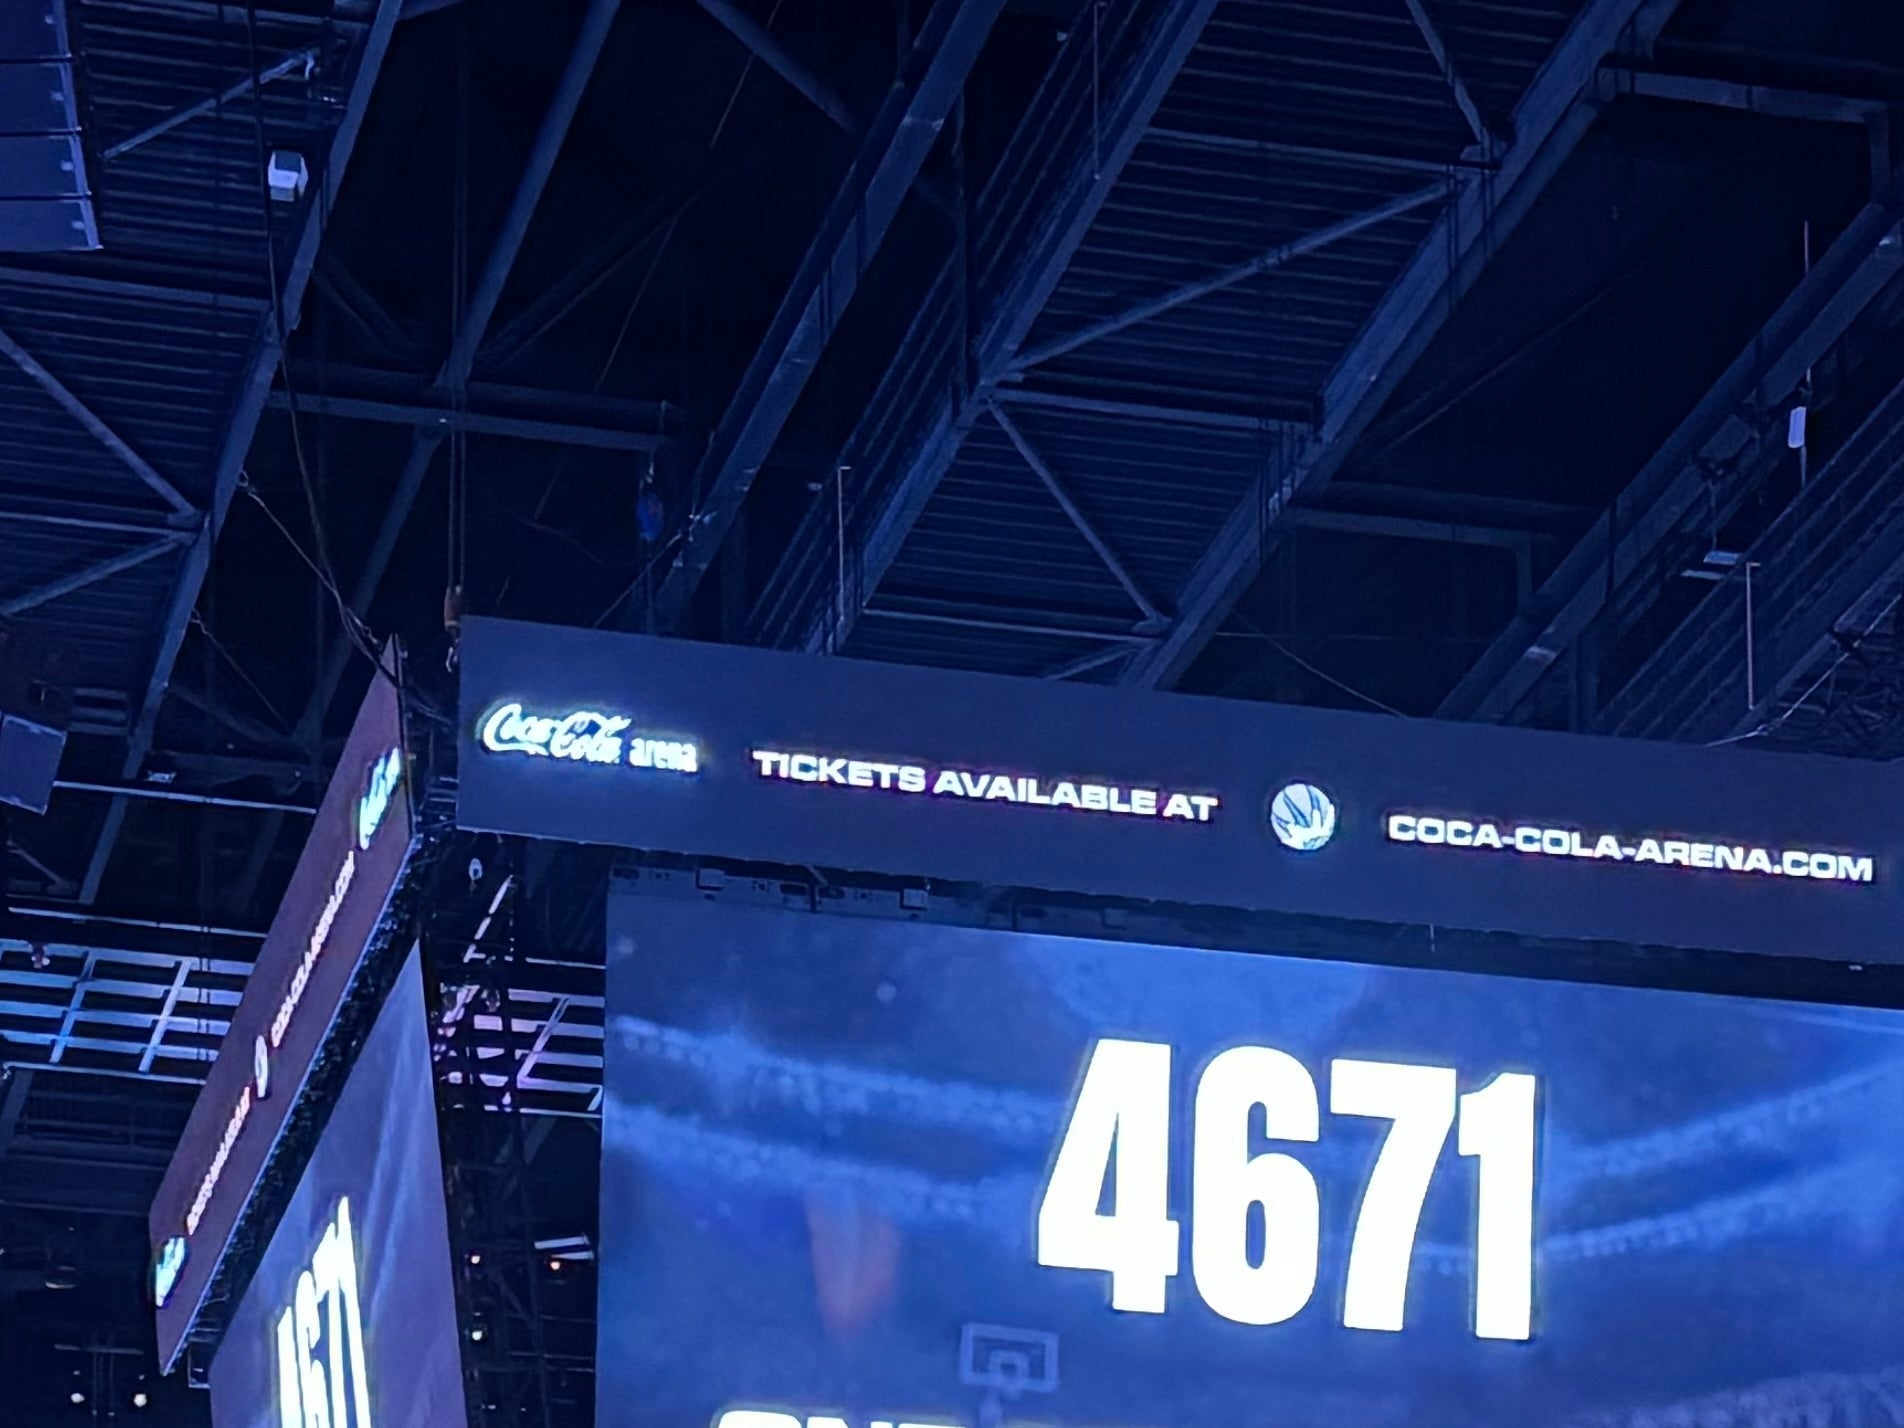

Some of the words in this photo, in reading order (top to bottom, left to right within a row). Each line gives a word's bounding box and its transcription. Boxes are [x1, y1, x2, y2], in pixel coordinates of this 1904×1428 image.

[753, 751, 925, 792] TICKETS
[933, 771, 1156, 814] AVAILABLE
[1163, 794, 1217, 820] AT
[1389, 815, 1872, 881] COCA-COLA-ARENA.COM
[1039, 1039, 1535, 1339] 4671
